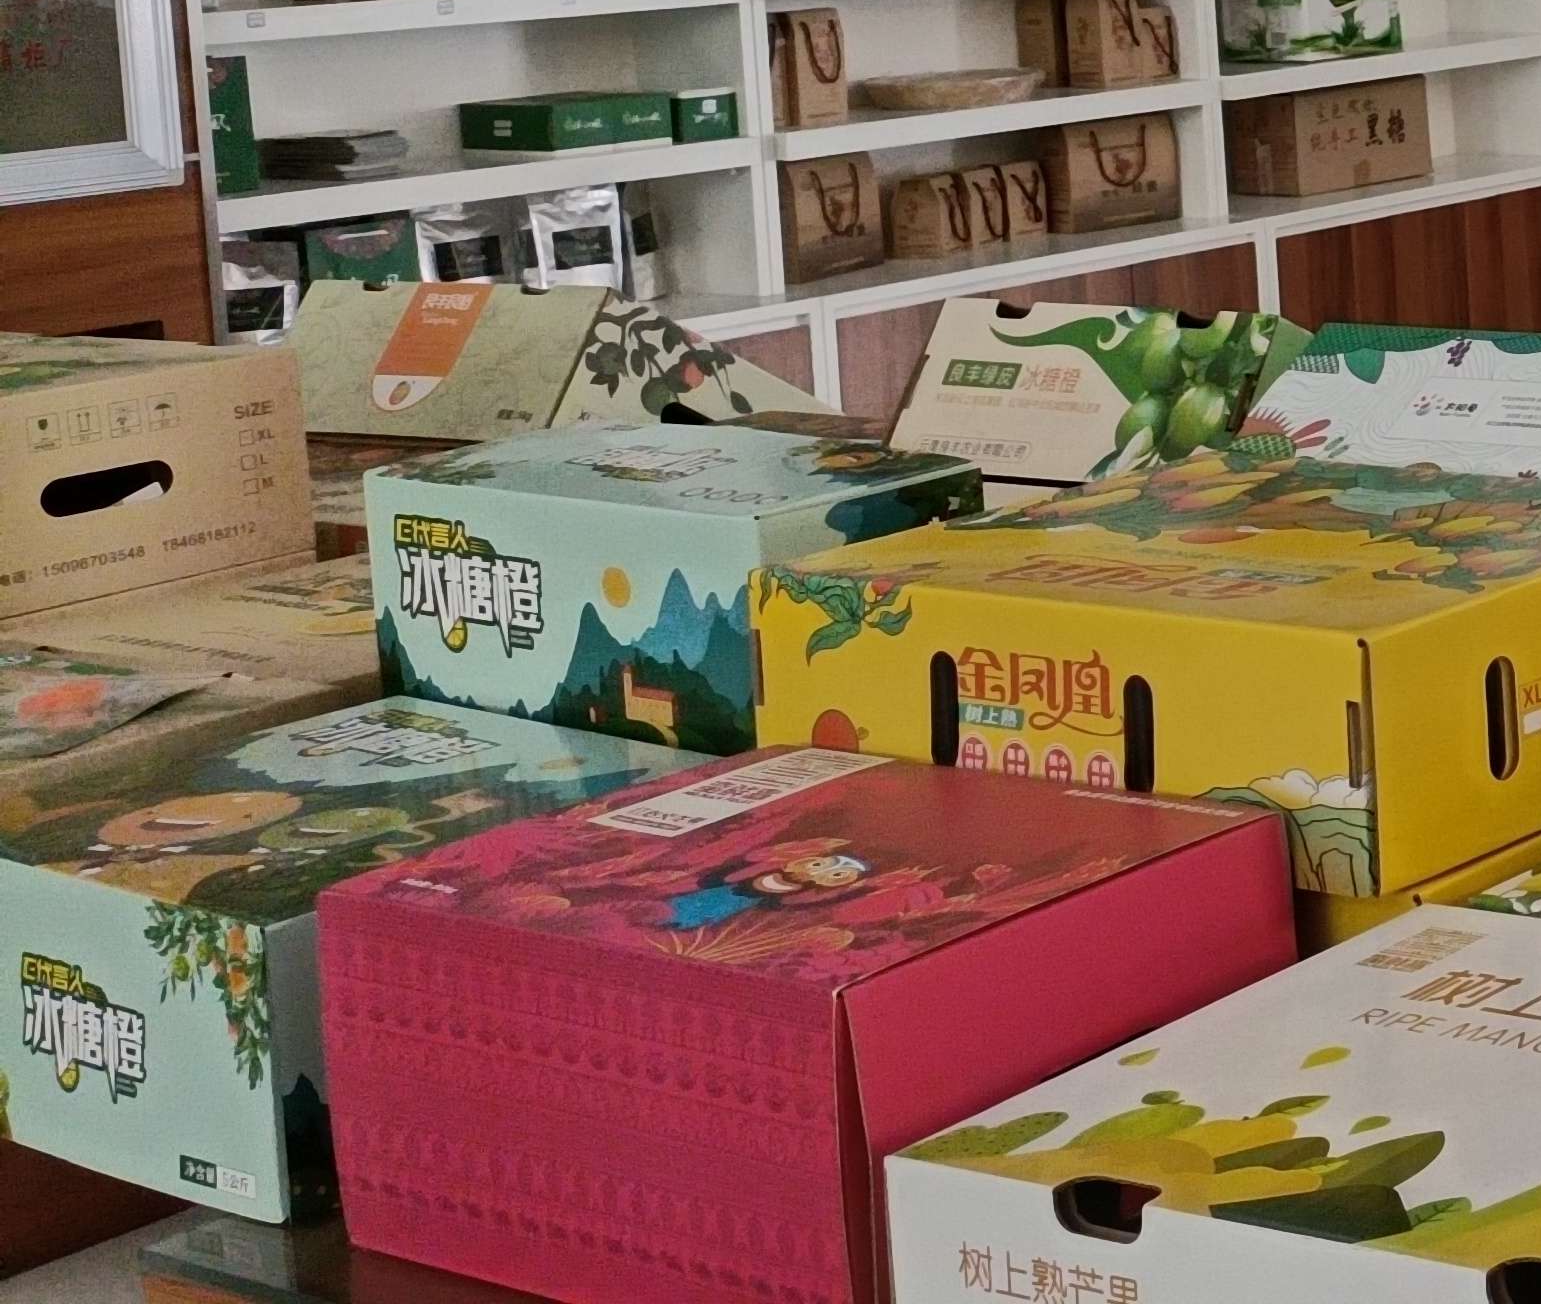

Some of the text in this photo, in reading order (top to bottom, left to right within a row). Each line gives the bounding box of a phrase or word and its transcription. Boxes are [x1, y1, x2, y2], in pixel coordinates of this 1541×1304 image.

[234, 401, 274, 420] SIZE
[401, 548, 543, 658] 冰糖橙
[957, 647, 1123, 728] 金凤凰
[24, 986, 146, 1102] 冰糖橙
[1352, 1007, 1441, 1034] RIPE
[958, 1241, 1140, 1304] 树上熟芒果
